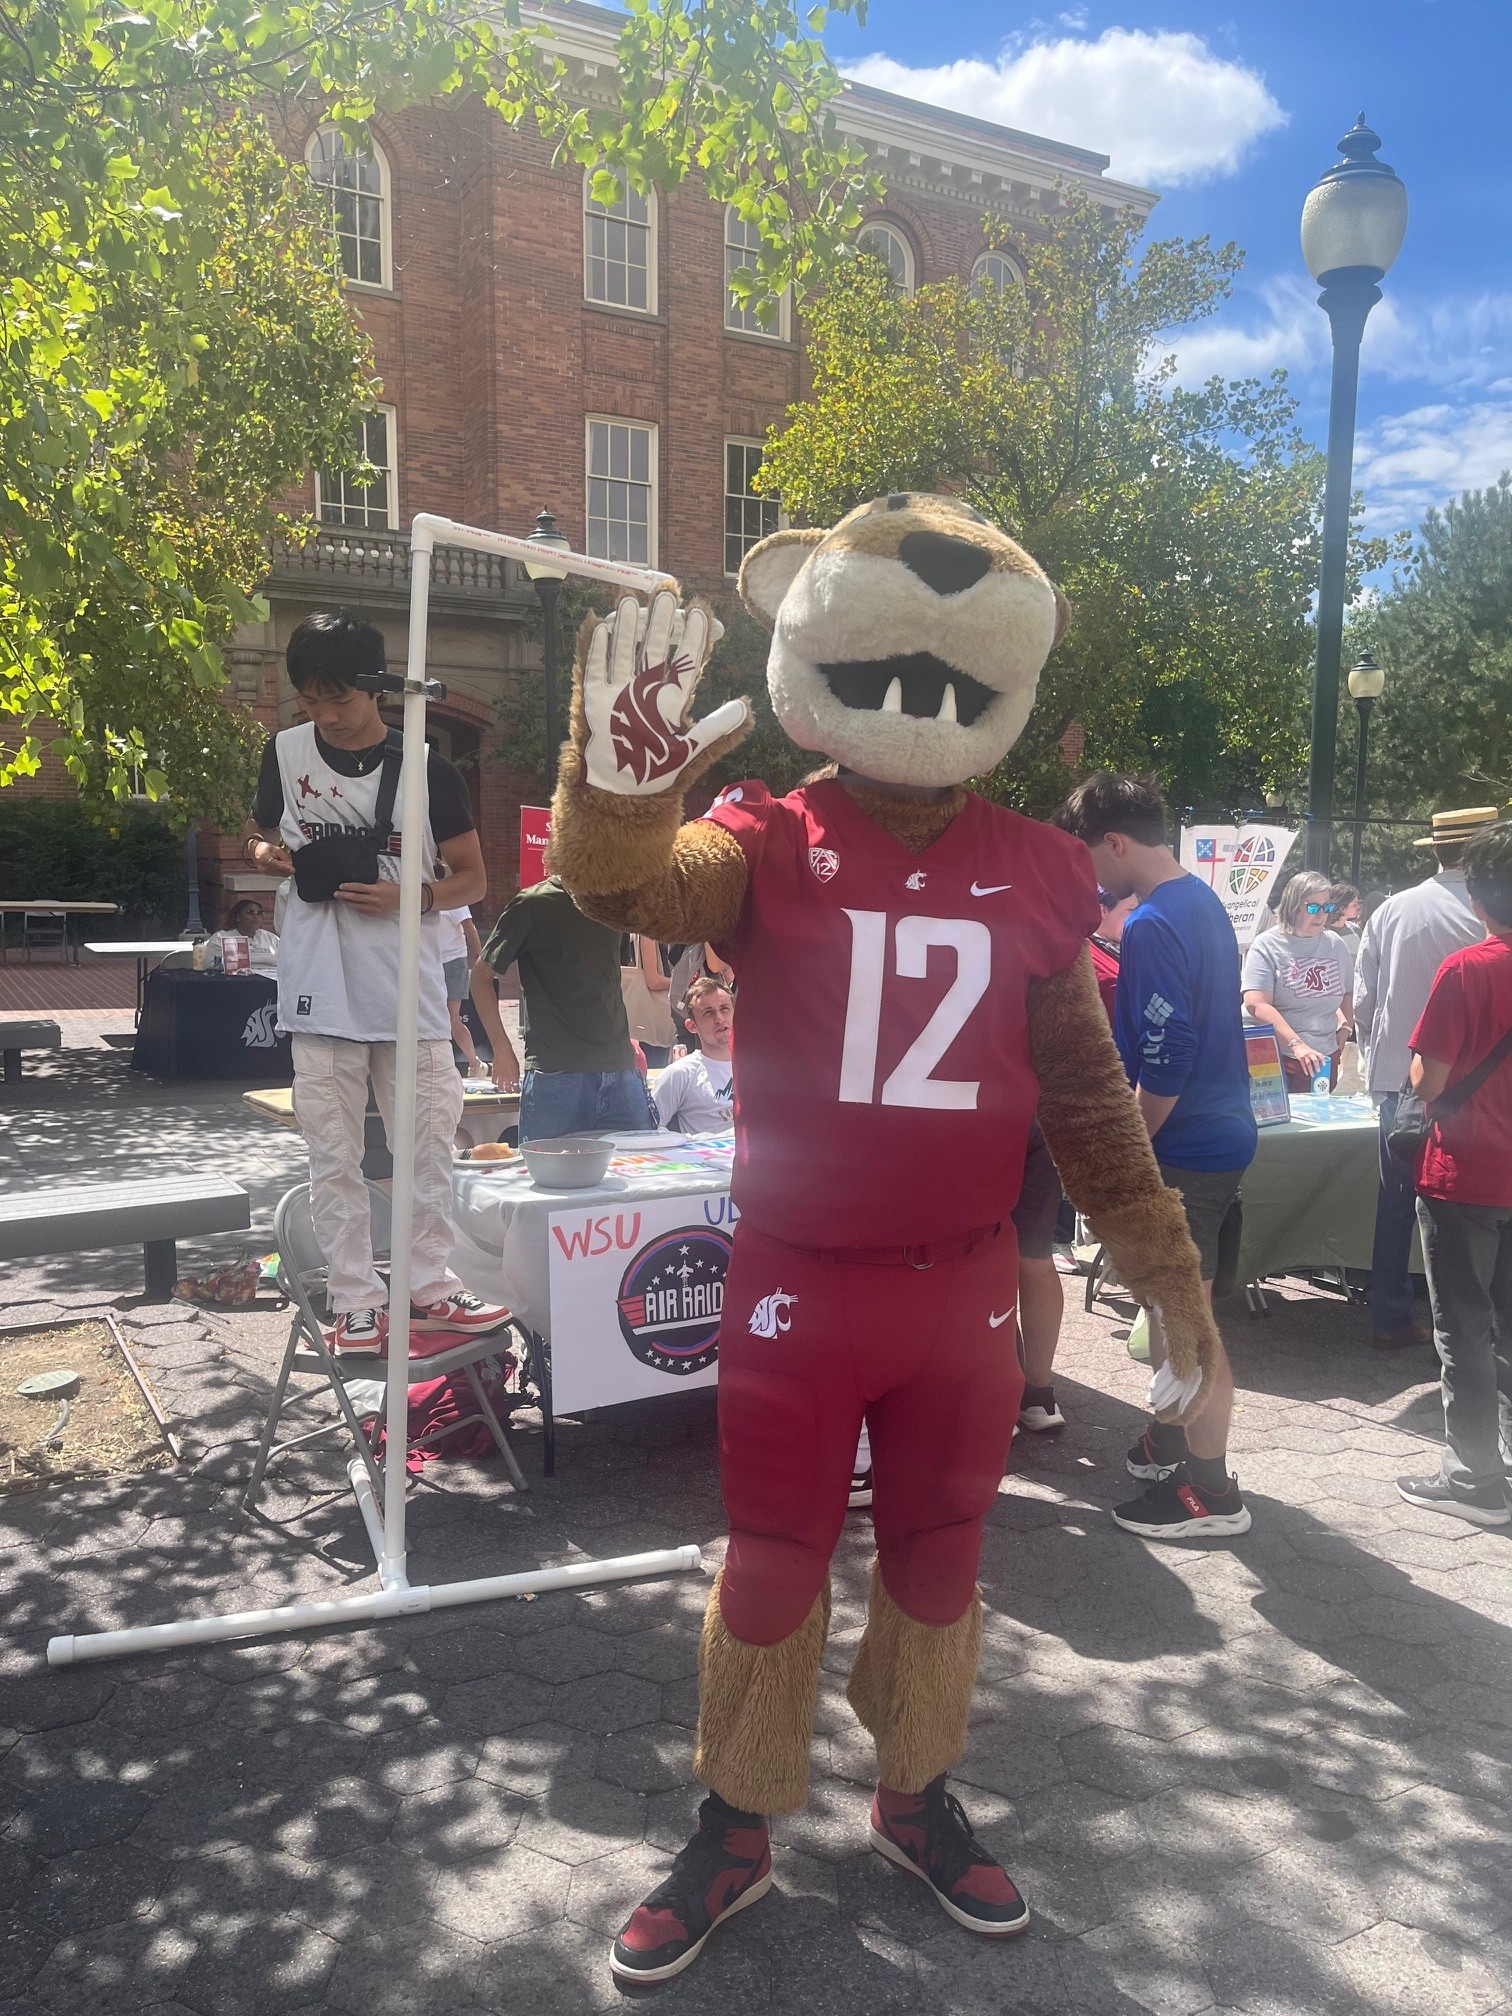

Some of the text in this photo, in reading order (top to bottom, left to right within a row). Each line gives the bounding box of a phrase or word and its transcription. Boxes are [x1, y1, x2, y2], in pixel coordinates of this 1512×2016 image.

[816, 862, 833, 876] 12
[1221, 898, 1260, 911] vangelical
[1228, 912, 1255, 923] heran
[838, 907, 992, 1110] 12
[551, 1211, 642, 1261] WSU
[645, 1281, 725, 1323] AIR RAID
[1186, 1496, 1200, 1512] FILA
